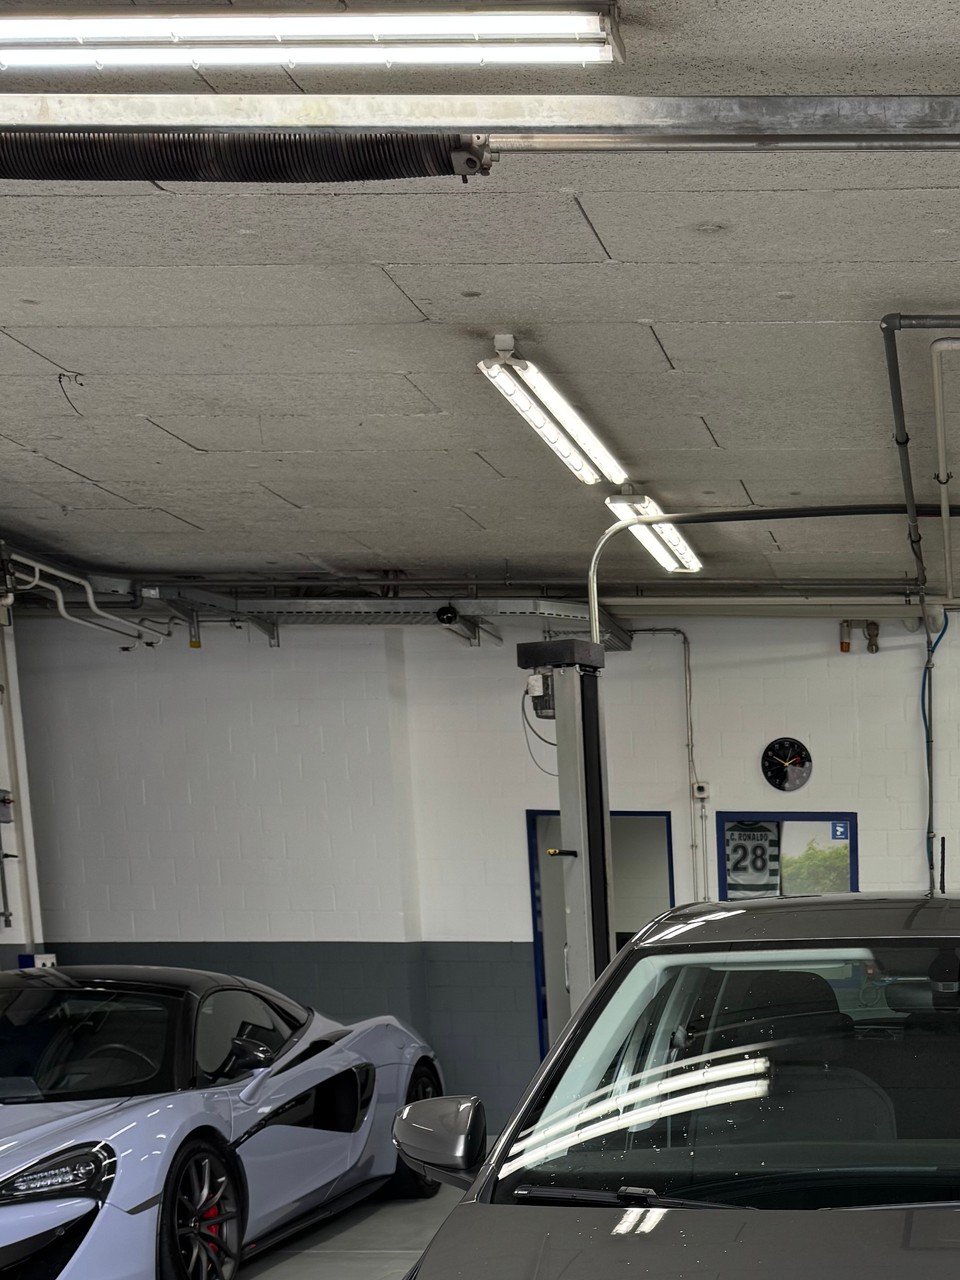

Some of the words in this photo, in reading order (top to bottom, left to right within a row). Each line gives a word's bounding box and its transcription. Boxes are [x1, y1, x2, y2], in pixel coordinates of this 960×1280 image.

[730, 833, 737, 841] C.
[738, 832, 769, 841] RONALDO
[731, 843, 768, 873] 28
